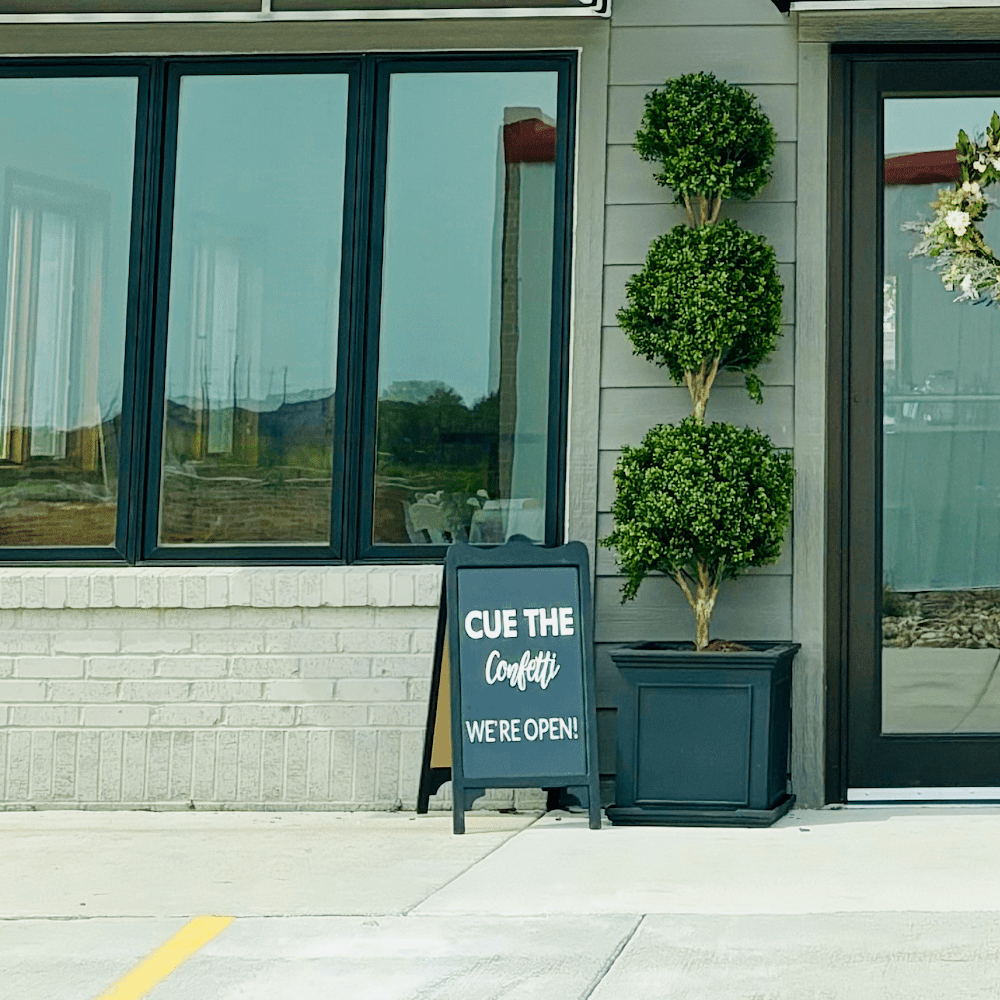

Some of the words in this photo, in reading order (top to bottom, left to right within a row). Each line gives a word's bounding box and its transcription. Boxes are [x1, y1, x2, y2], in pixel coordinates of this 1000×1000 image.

[464, 608, 518, 639] CUE
[522, 607, 575, 637] THE
[485, 649, 561, 691] Confetti
[465, 718, 521, 743] WE'RE
[523, 716, 579, 742] OPEN!
